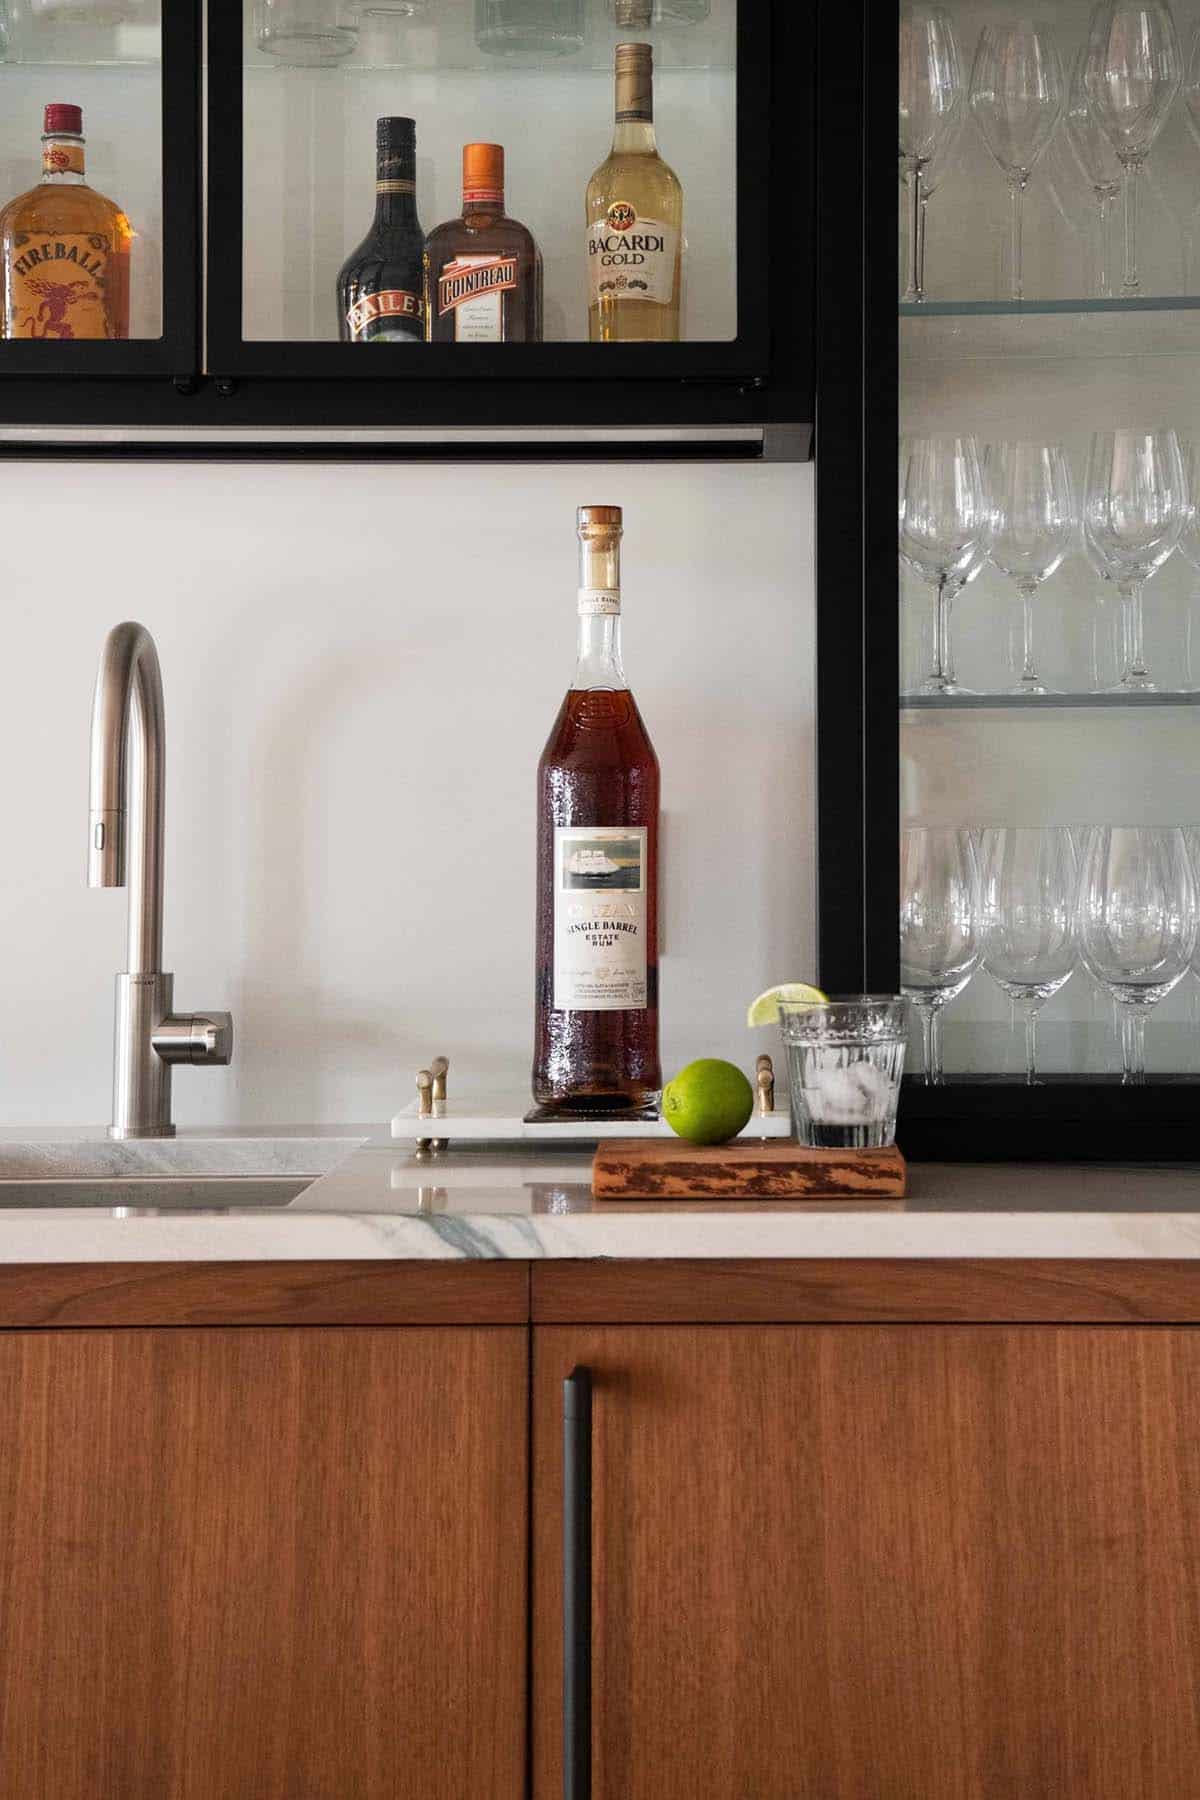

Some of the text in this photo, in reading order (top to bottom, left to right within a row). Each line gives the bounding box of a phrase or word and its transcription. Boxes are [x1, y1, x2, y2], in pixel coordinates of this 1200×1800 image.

[589, 235, 664, 255] BACARDI
[13, 242, 102, 277] FIREBALL
[601, 253, 645, 266] GOLD
[443, 264, 513, 307] COINTREAU
[603, 921, 638, 936] BARREL
